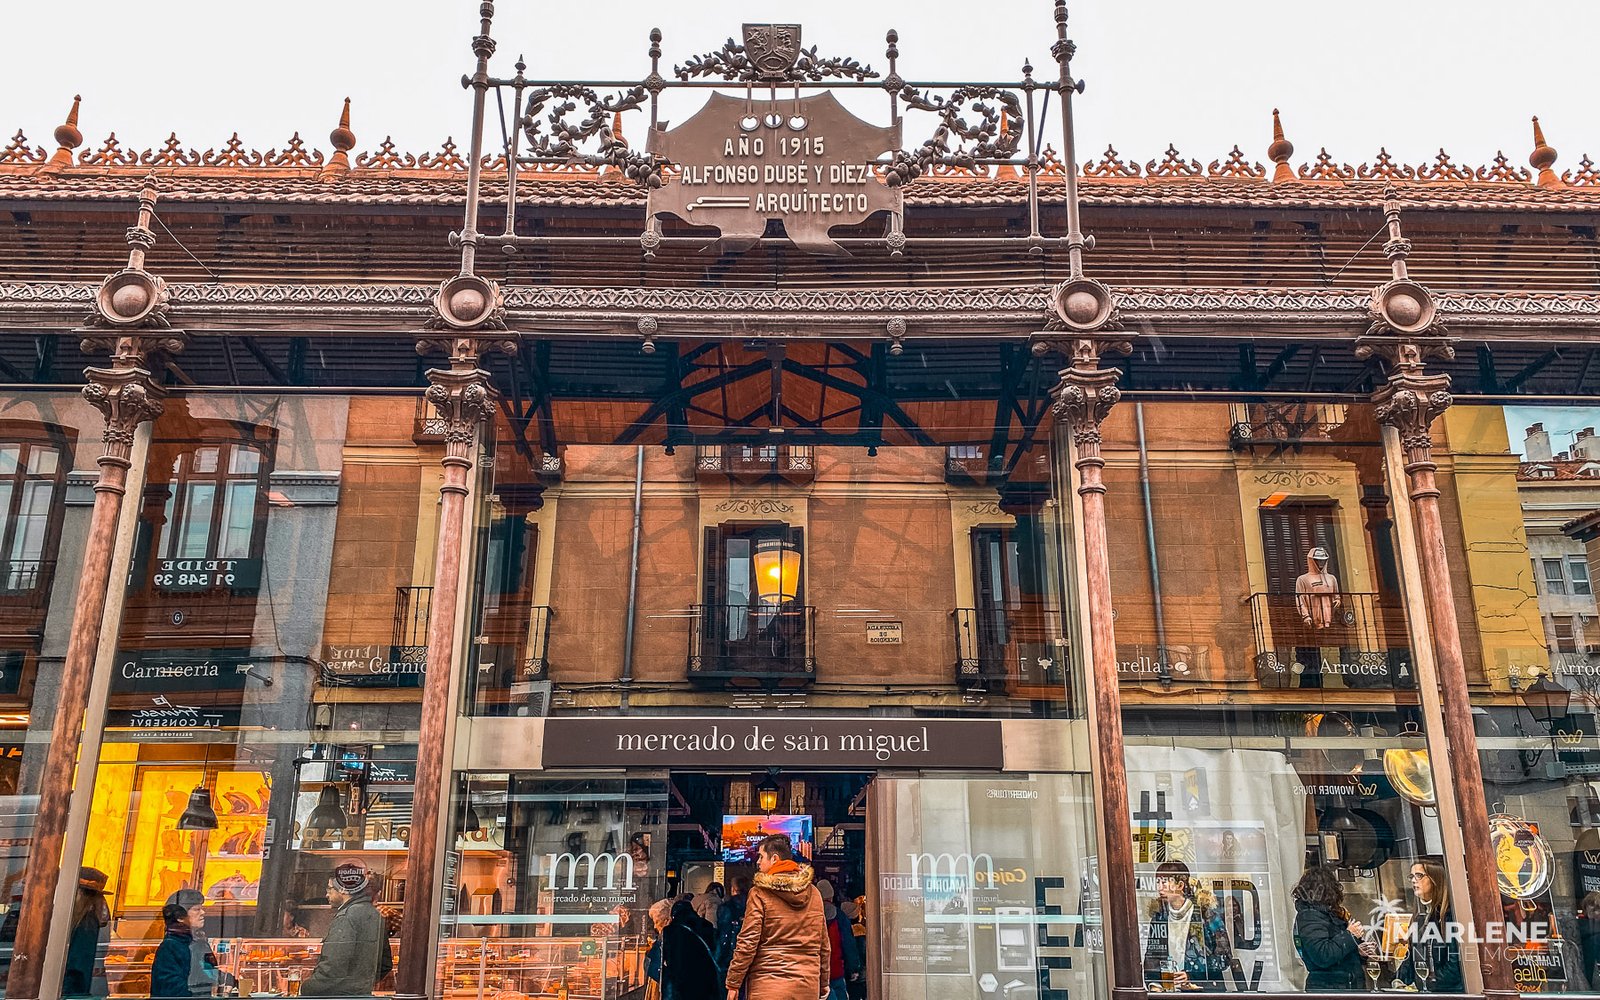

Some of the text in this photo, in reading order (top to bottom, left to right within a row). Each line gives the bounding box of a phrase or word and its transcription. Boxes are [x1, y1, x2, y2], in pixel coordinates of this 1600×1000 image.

[723, 133, 825, 156] AÑO 1915
[681, 164, 759, 184] ALFONSO
[764, 160, 809, 184] DUBÉ
[814, 165, 824, 184] Y
[122, 660, 219, 679] Carnicería
[1320, 658, 1388, 676] Arroces
[616, 725, 930, 761] mercado de san miguel
[543, 894, 578, 903] mercado
[580, 893, 591, 903] de
[609, 894, 637, 905] miguel
